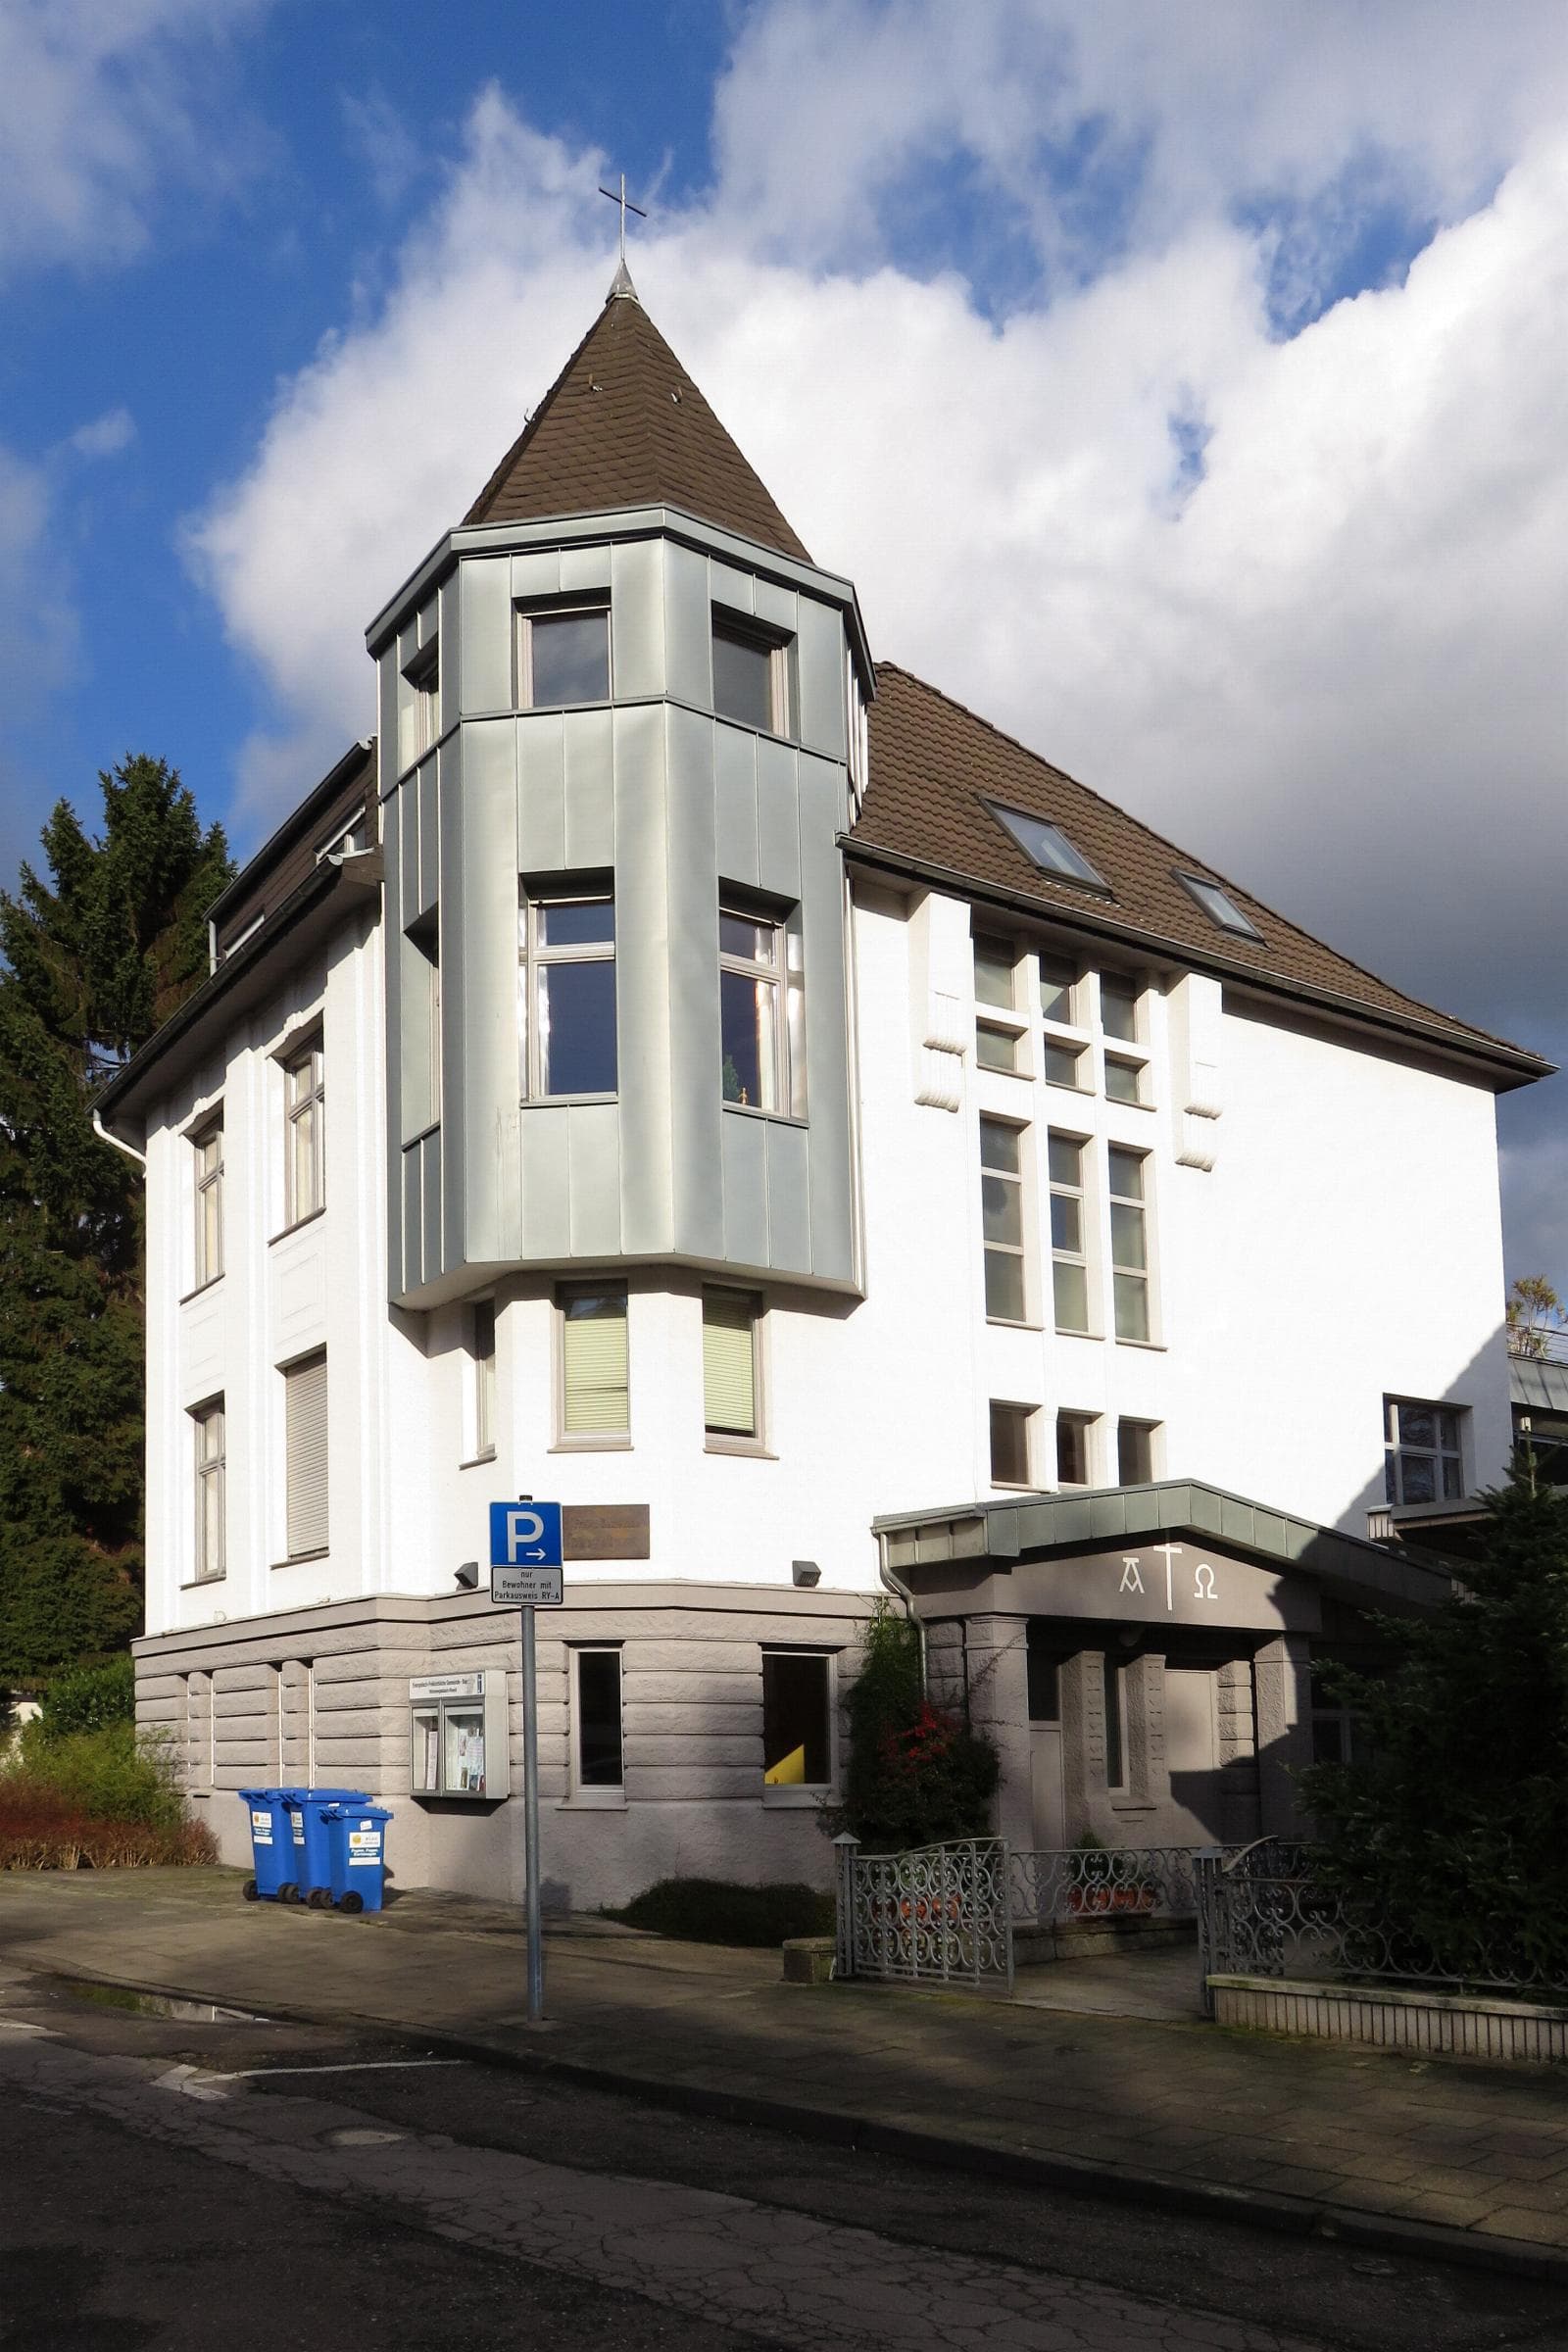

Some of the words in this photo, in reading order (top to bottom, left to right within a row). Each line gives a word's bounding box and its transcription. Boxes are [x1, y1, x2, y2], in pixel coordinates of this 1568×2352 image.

[507, 1511, 544, 1562] P
[520, 1570, 533, 1579] nur
[502, 1580, 536, 1589] Bewohner
[494, 1591, 538, 1599] Parkausweis
